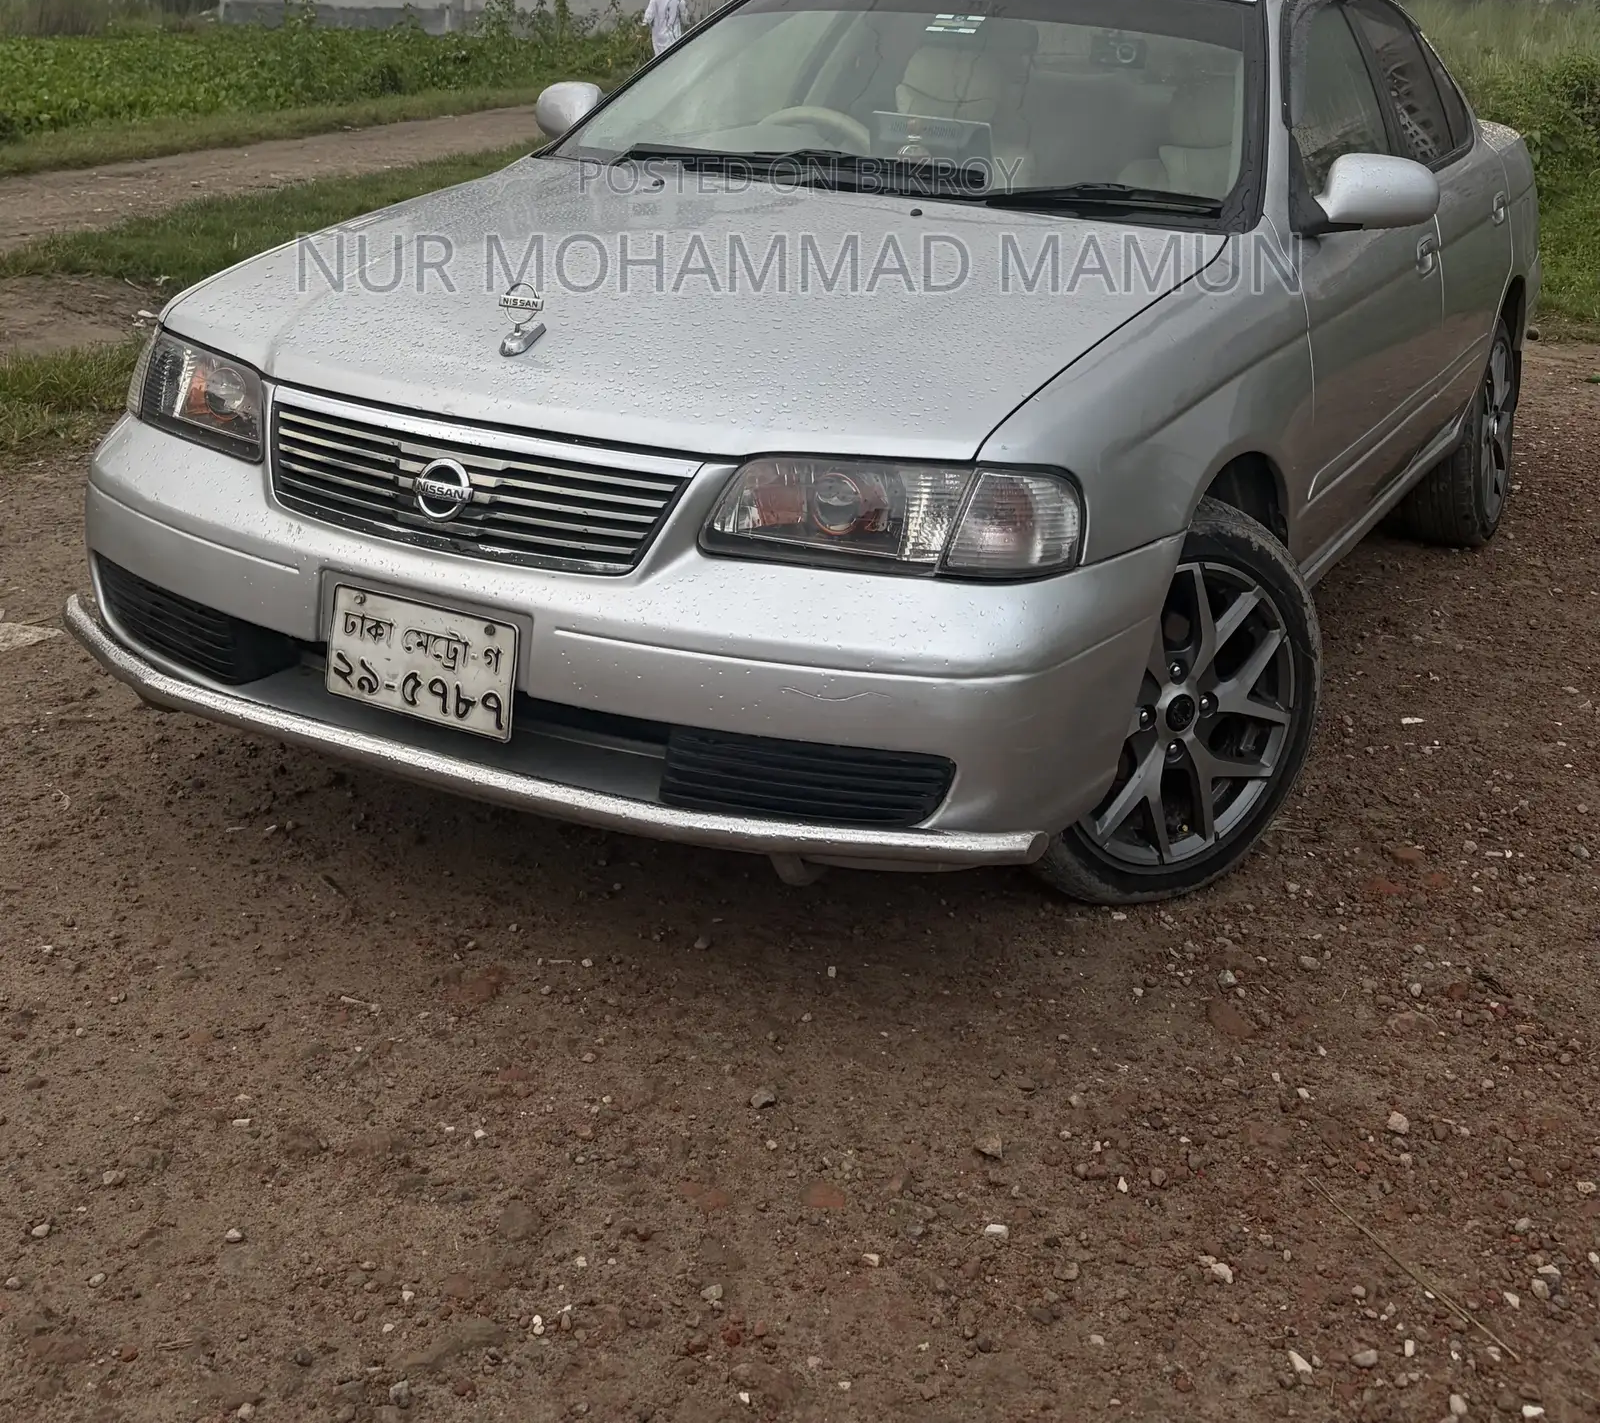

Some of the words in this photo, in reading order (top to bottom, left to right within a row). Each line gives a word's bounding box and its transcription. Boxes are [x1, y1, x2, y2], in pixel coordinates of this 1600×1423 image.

[502, 297, 539, 308] NISSAN
[416, 479, 465, 500] NISSAN
[343, 611, 396, 648] ঢাকা
